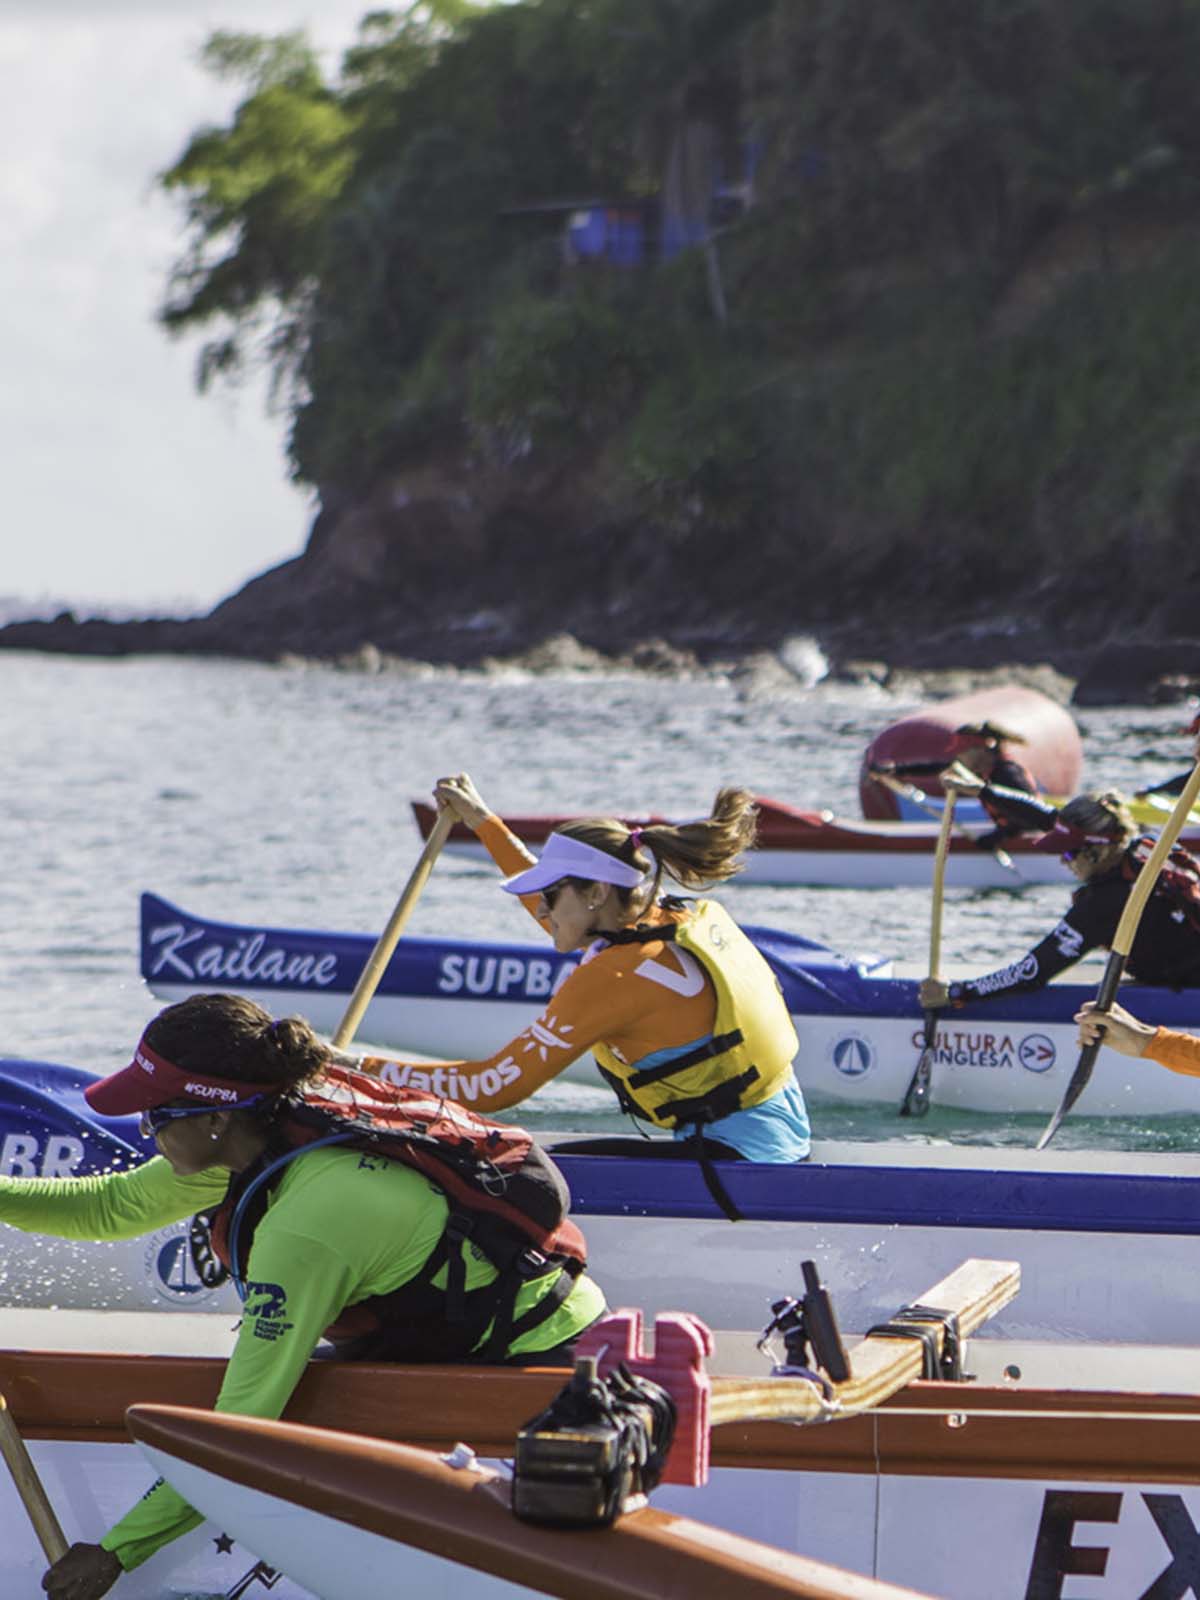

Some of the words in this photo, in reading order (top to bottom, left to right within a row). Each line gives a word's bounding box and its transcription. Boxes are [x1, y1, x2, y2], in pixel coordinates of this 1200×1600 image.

[150, 923, 338, 985] Kailane
[912, 1031, 1015, 1053] CULTURA
[933, 1051, 1013, 1068] INGLESA
[379, 1055, 522, 1101] Nativos
